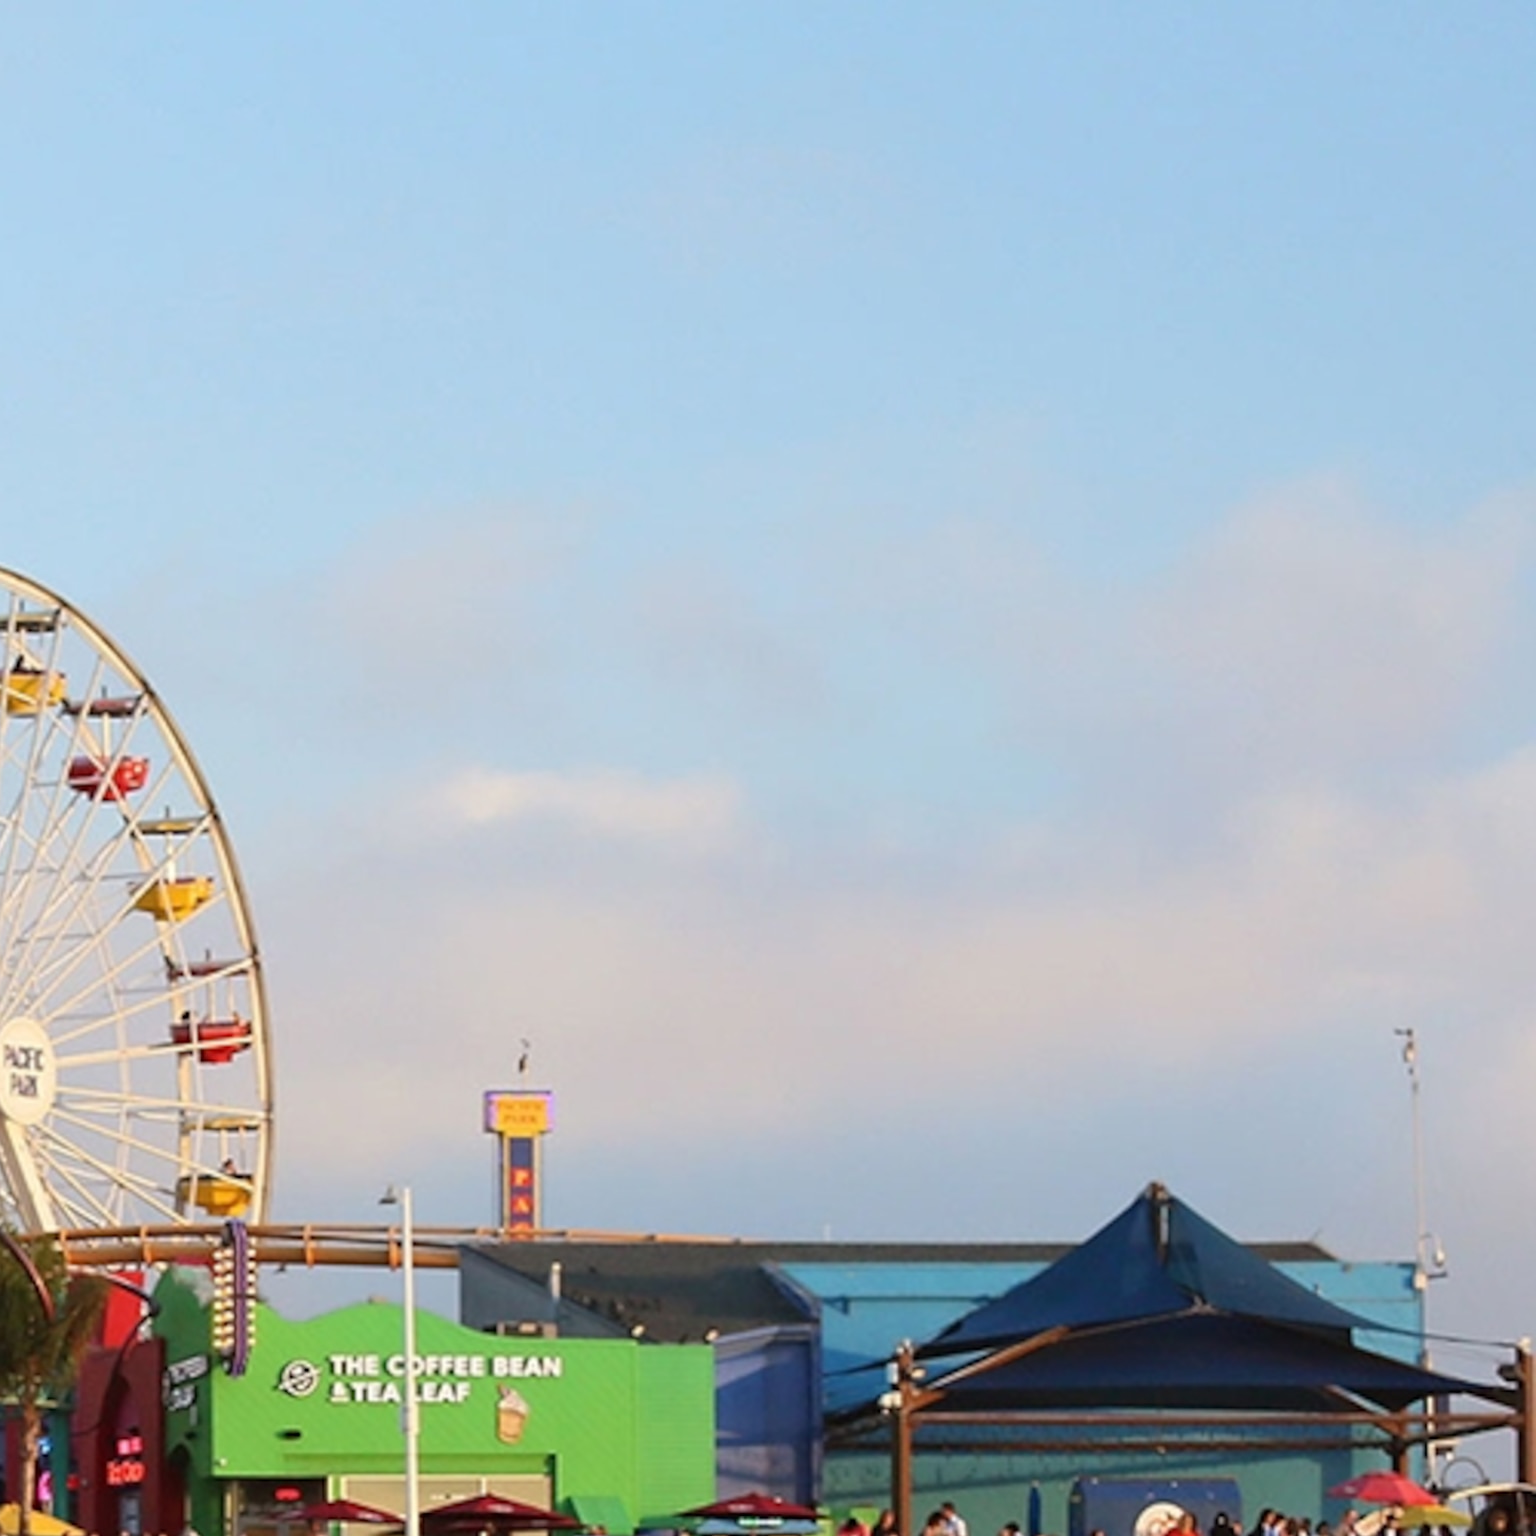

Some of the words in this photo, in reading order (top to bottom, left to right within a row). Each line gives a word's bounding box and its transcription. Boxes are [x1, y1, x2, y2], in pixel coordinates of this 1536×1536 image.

[2, 1044, 44, 1072] PACIFIC
[10, 1073, 39, 1098] PARK
[329, 1355, 379, 1377] THE
[386, 1355, 485, 1377] COFFEE
[492, 1355, 562, 1378] BEAN
